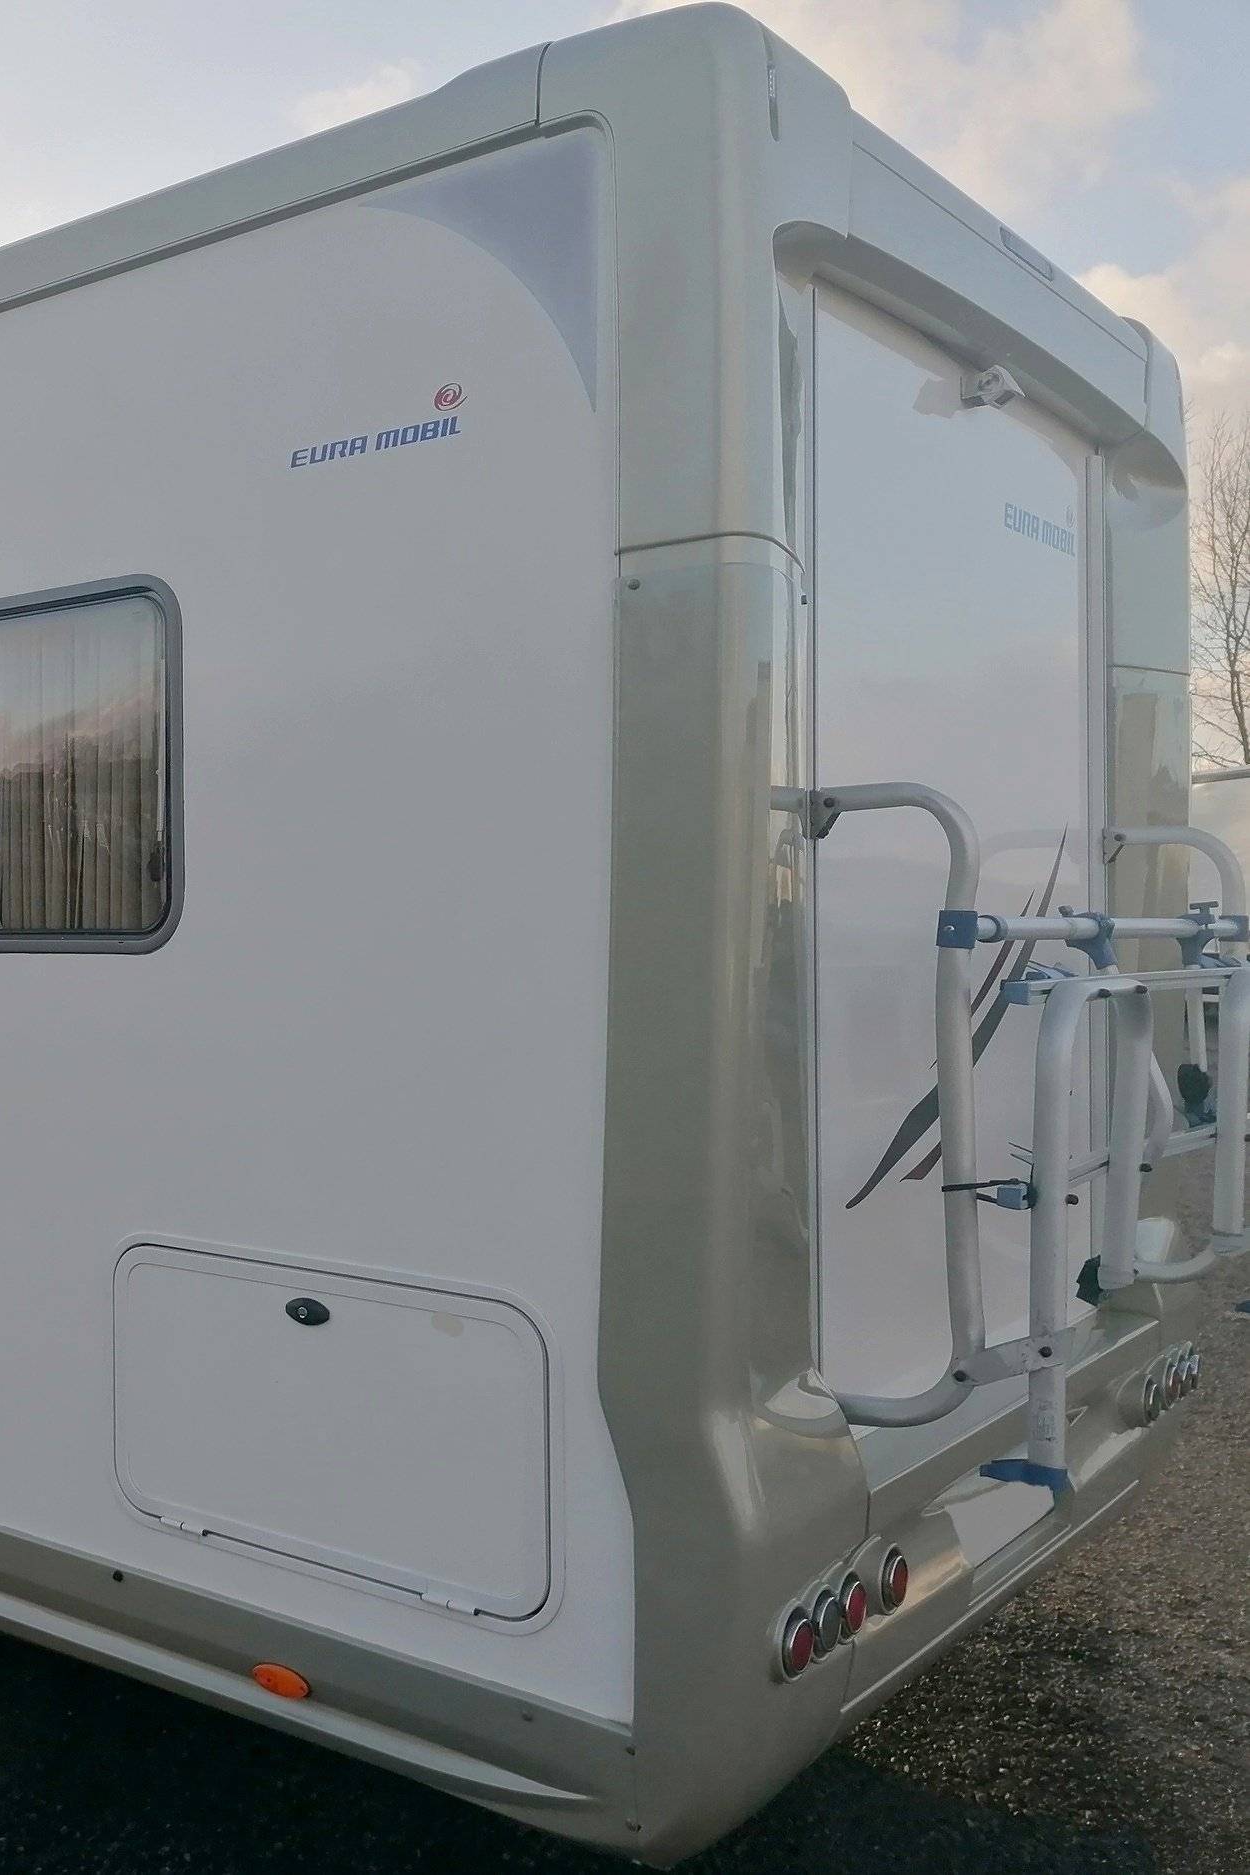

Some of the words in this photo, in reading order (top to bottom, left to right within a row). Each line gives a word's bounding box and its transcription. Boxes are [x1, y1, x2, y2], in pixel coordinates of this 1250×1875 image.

[290, 435, 368, 468] EURA
[374, 415, 462, 451] MOBIL
[1004, 502, 1040, 541] EURA
[1041, 519, 1076, 557] MOBIL
